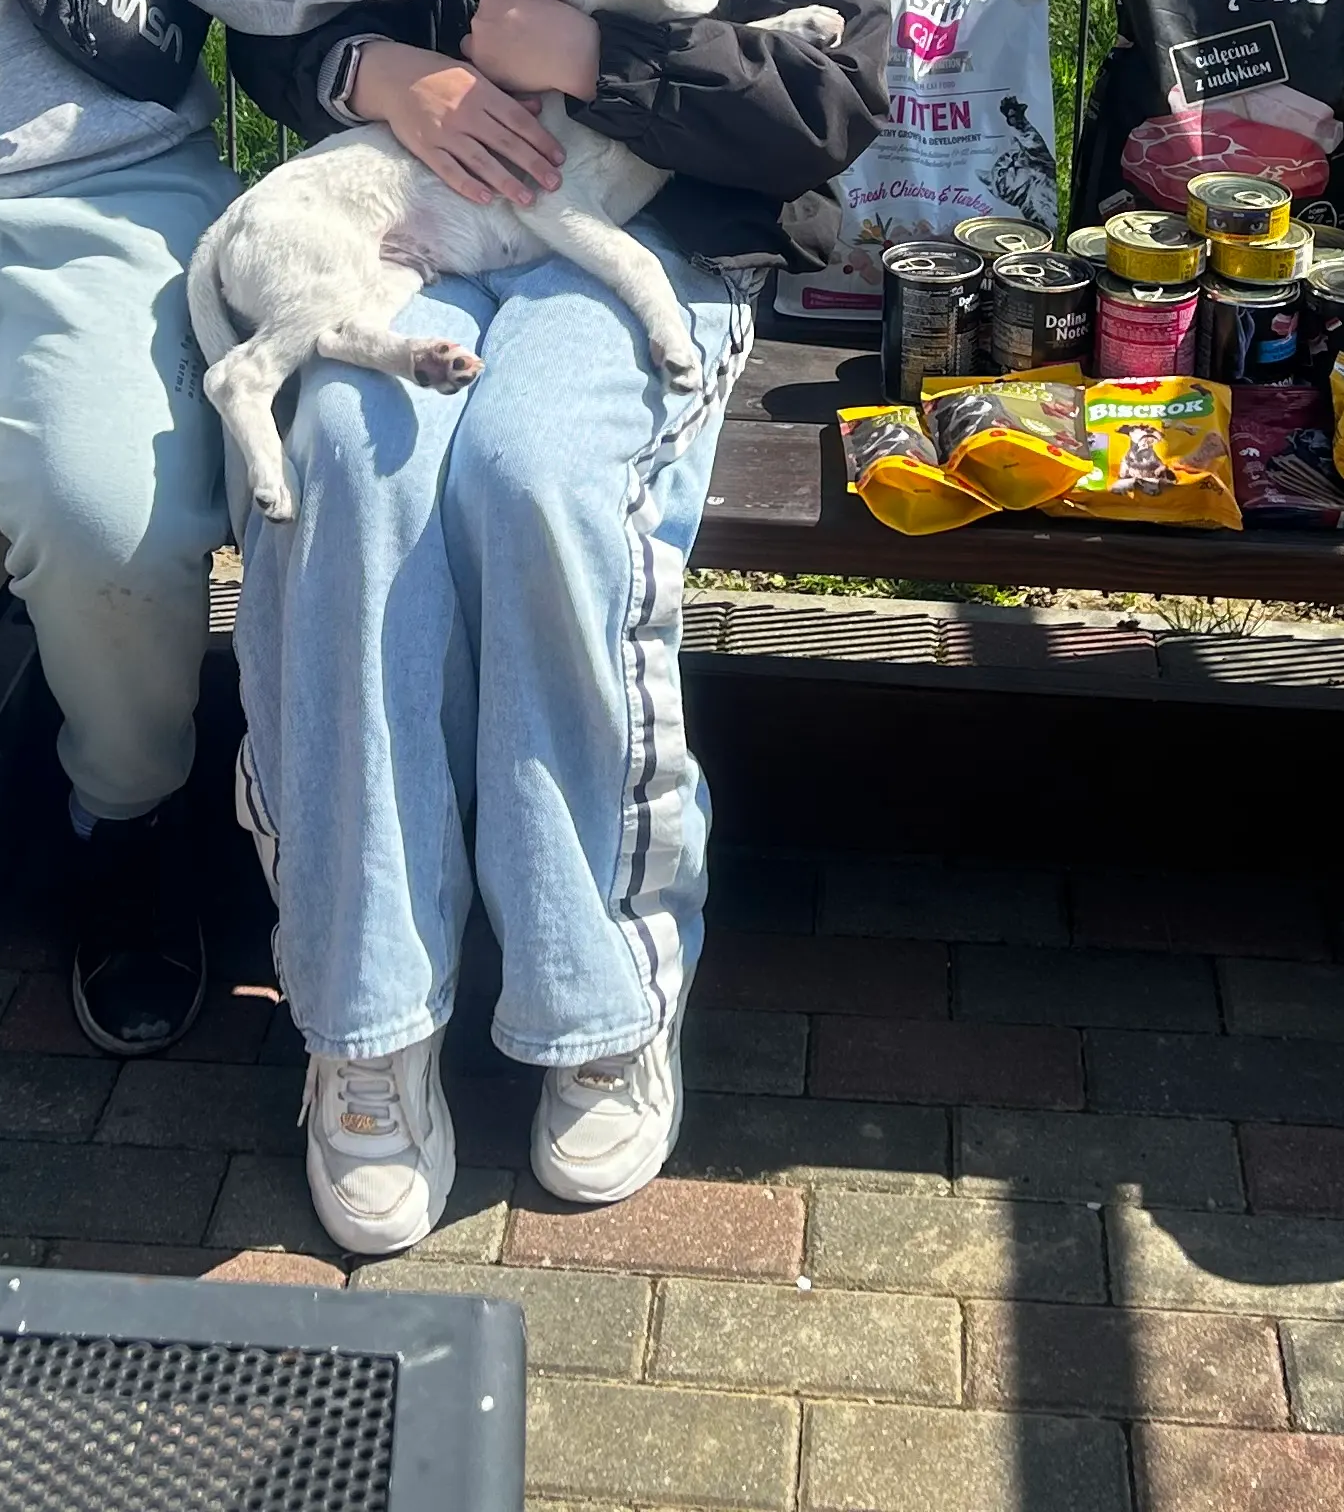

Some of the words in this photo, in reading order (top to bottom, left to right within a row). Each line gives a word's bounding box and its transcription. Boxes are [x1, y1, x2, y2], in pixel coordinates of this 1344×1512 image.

[1195, 40, 1261, 69] cielęcina
[1194, 78, 1204, 92] z
[1205, 59, 1272, 89] indykiem
[928, 133, 982, 146] DEVELOPMENT
[848, 184, 888, 209] Fresh
[889, 179, 936, 202] Chicken
[938, 185, 951, 207] &
[952, 187, 993, 216] Turkey
[1088, 399, 1204, 422] BISCROK
